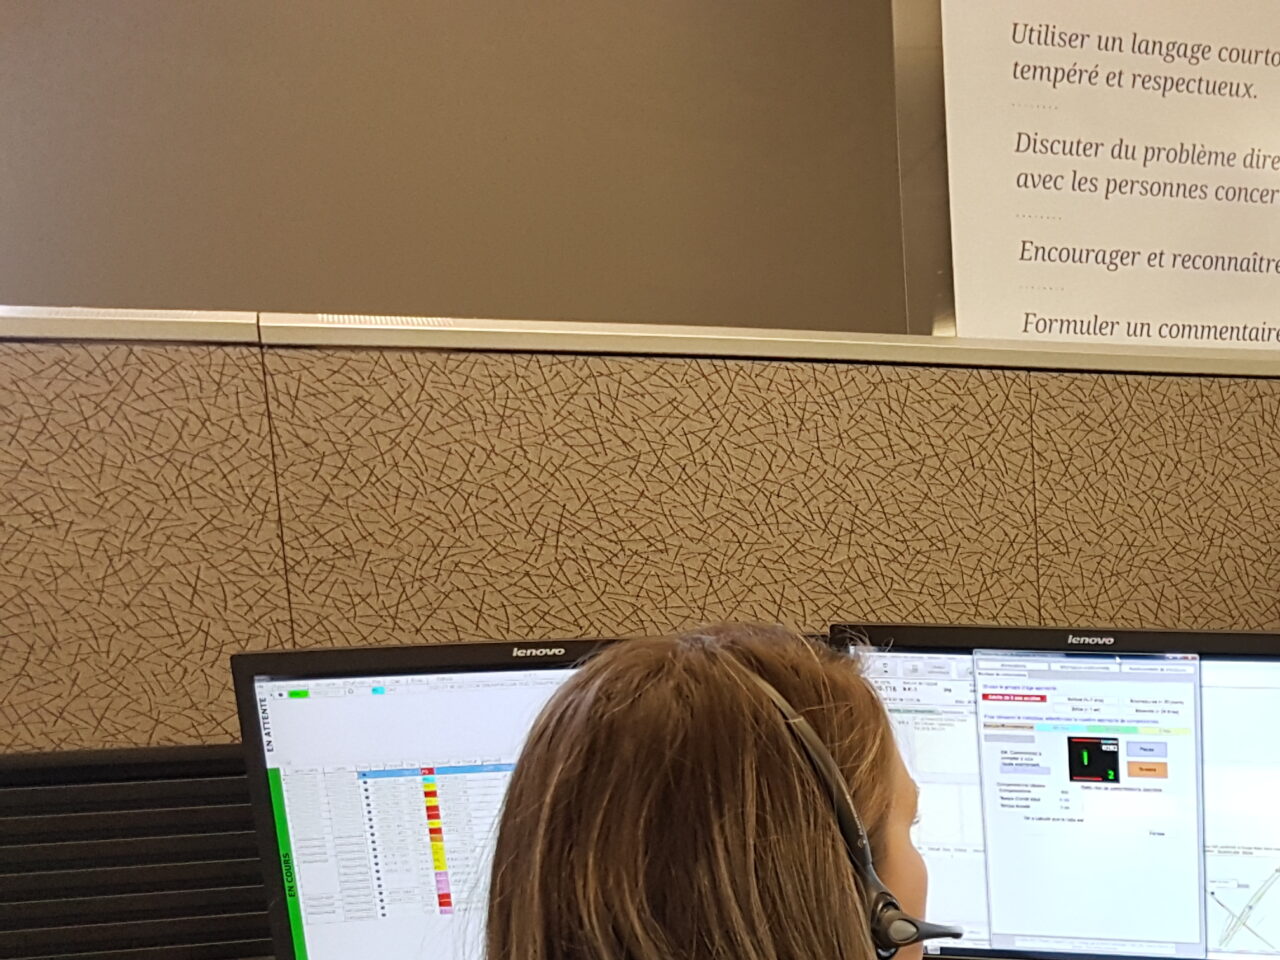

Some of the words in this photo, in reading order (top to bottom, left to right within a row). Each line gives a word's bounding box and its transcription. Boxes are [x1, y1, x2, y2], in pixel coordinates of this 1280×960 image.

[1011, 21, 1091, 50] Utiliser
[1096, 34, 1125, 54] un
[1130, 31, 1212, 67] langage
[1012, 60, 1100, 90] tempéré
[1105, 68, 1125, 89] et
[1131, 72, 1258, 100] respectueux.
[1013, 131, 1106, 159] Discuter
[1110, 137, 1138, 162] du
[1142, 141, 1238, 169] problème
[1015, 171, 1065, 192] avec
[1071, 168, 1100, 194] les
[1104, 177, 1209, 201] personnes
[1018, 239, 1142, 273] Encourager
[1146, 248, 1166, 269] et
[1021, 311, 1121, 337] Formuler
[1125, 320, 1153, 339] un
[512, 647, 566, 657] lenovo
[1067, 634, 1115, 645] lenovo
